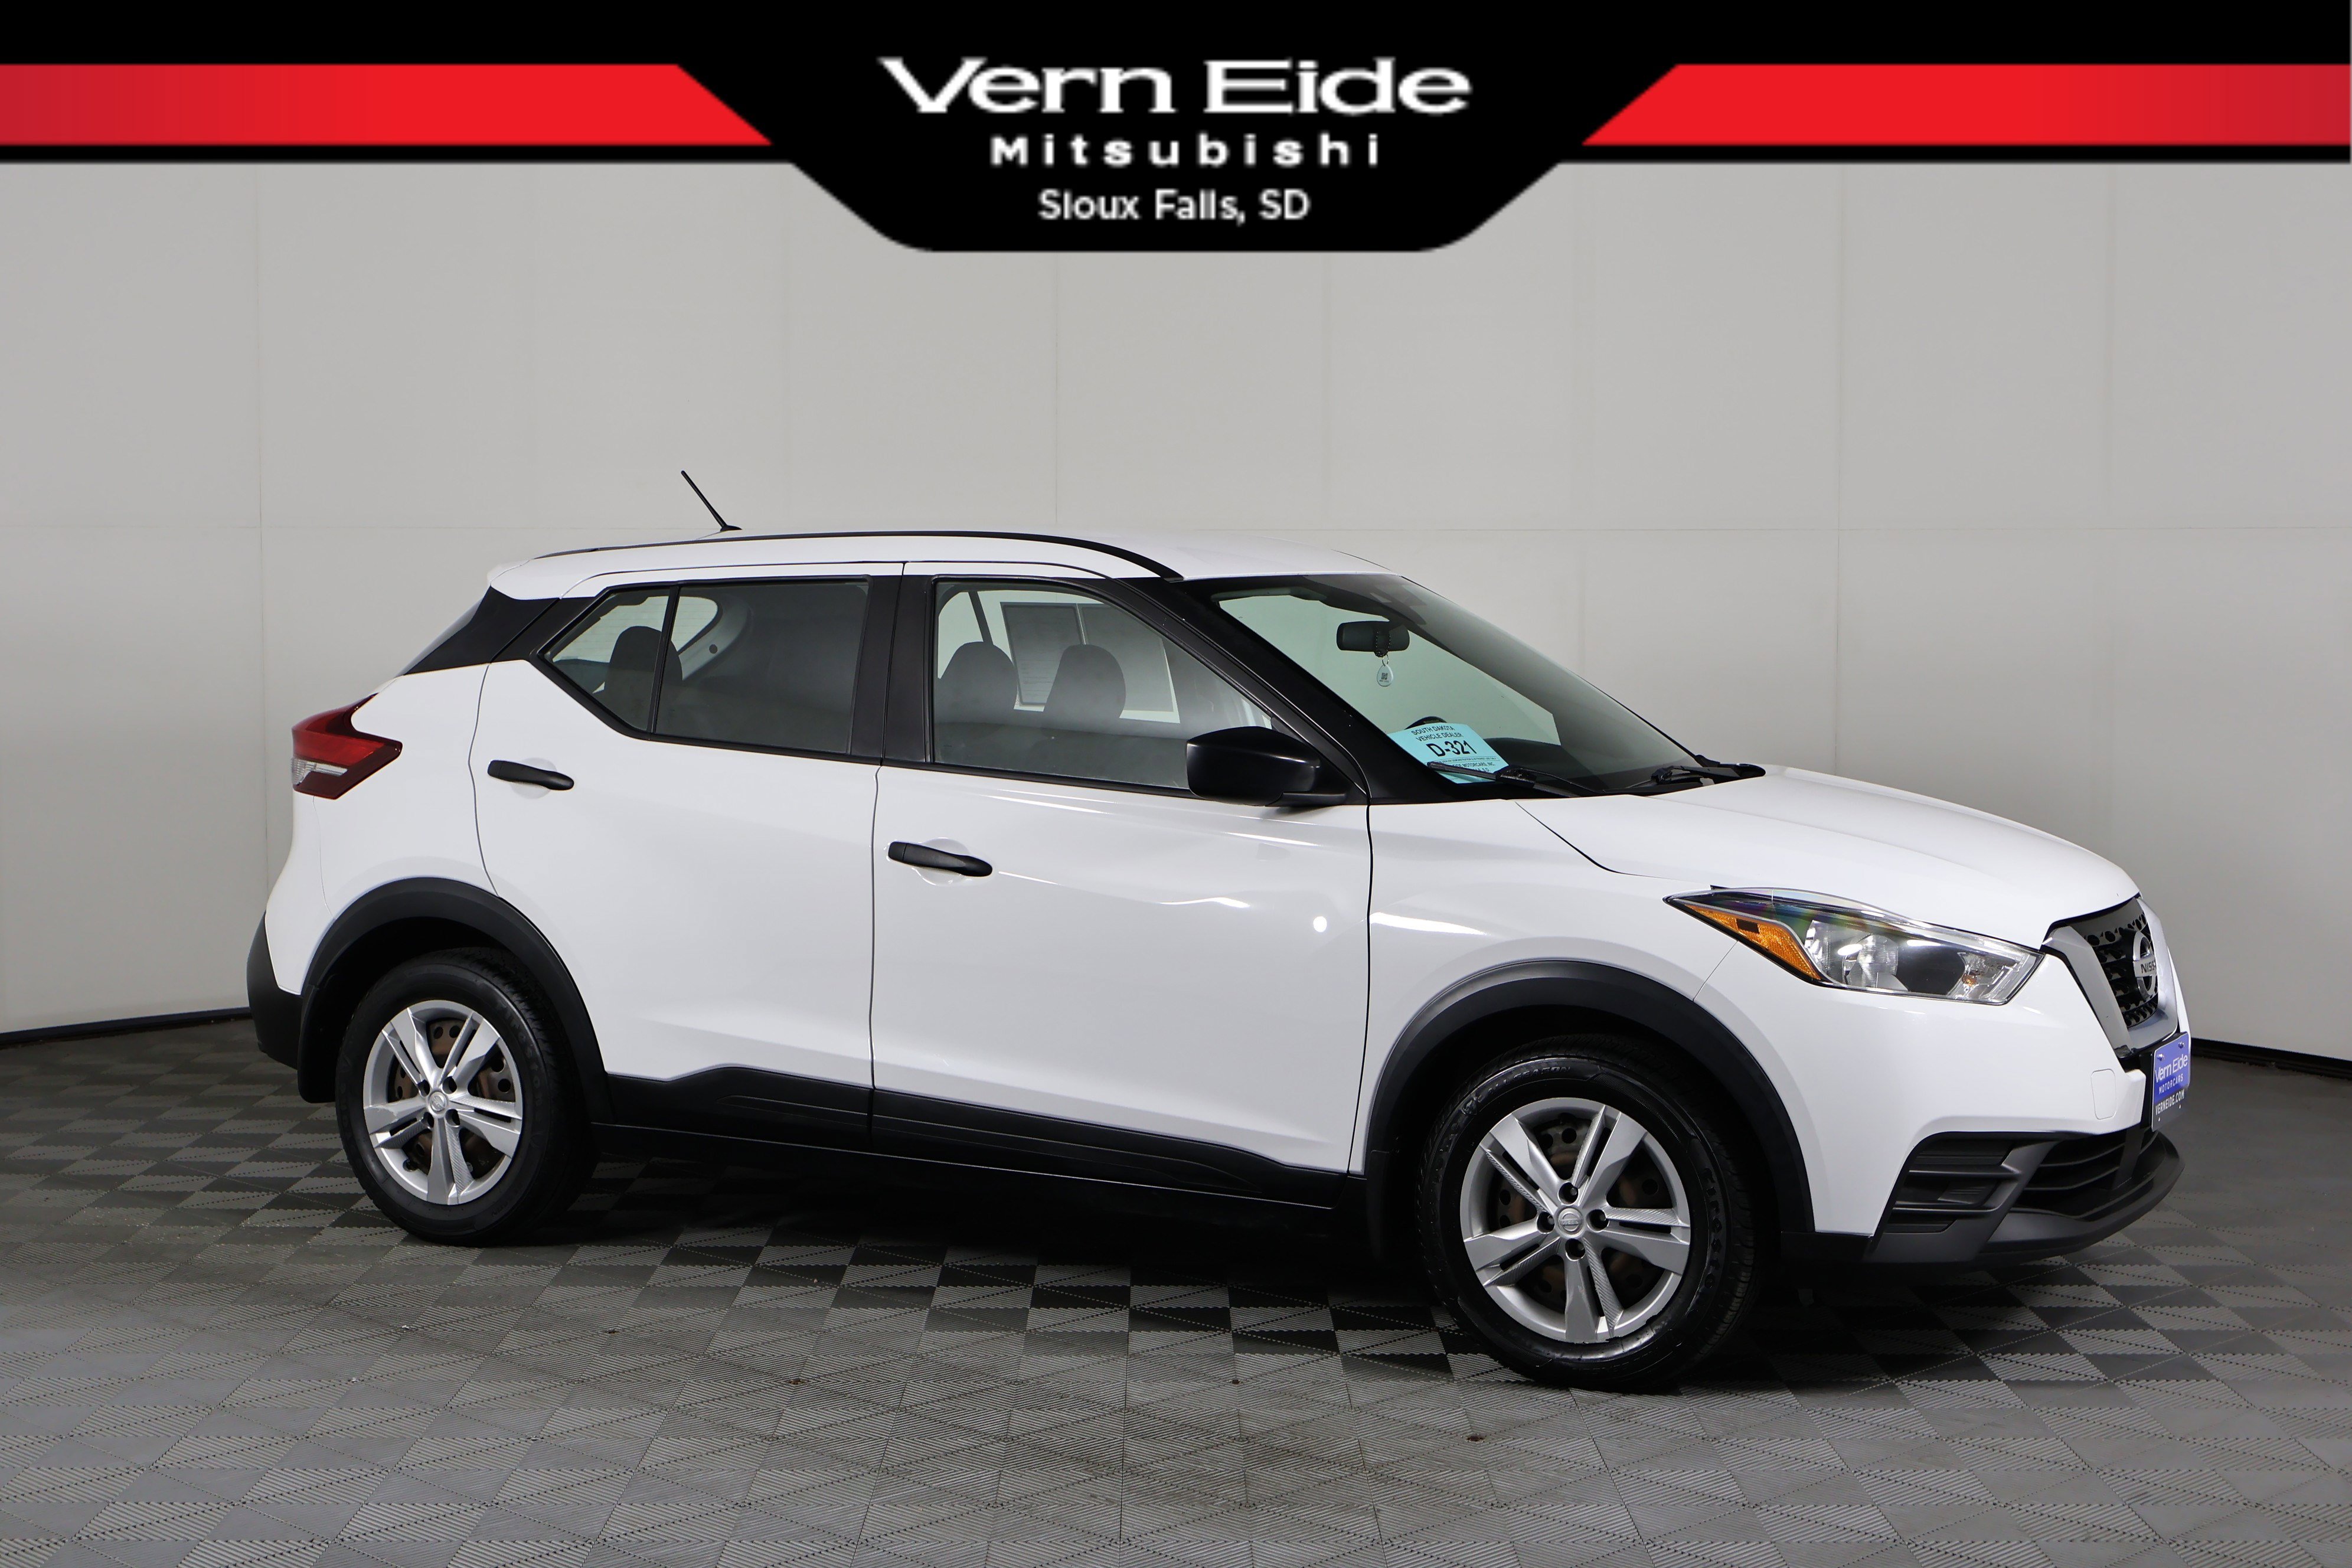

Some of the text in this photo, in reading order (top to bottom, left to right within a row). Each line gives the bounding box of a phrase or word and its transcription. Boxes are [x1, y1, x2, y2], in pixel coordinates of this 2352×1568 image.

[1412, 726, 1433, 735] SOUTH
[1416, 733, 1443, 741] VEHICLE
[1426, 740, 1477, 757] D-321
[2155, 1054, 2188, 1083] Vern Eide
[2158, 1073, 2183, 1095] MOTORCARS
[2155, 1089, 2185, 1116] VERNEIDE.COM
